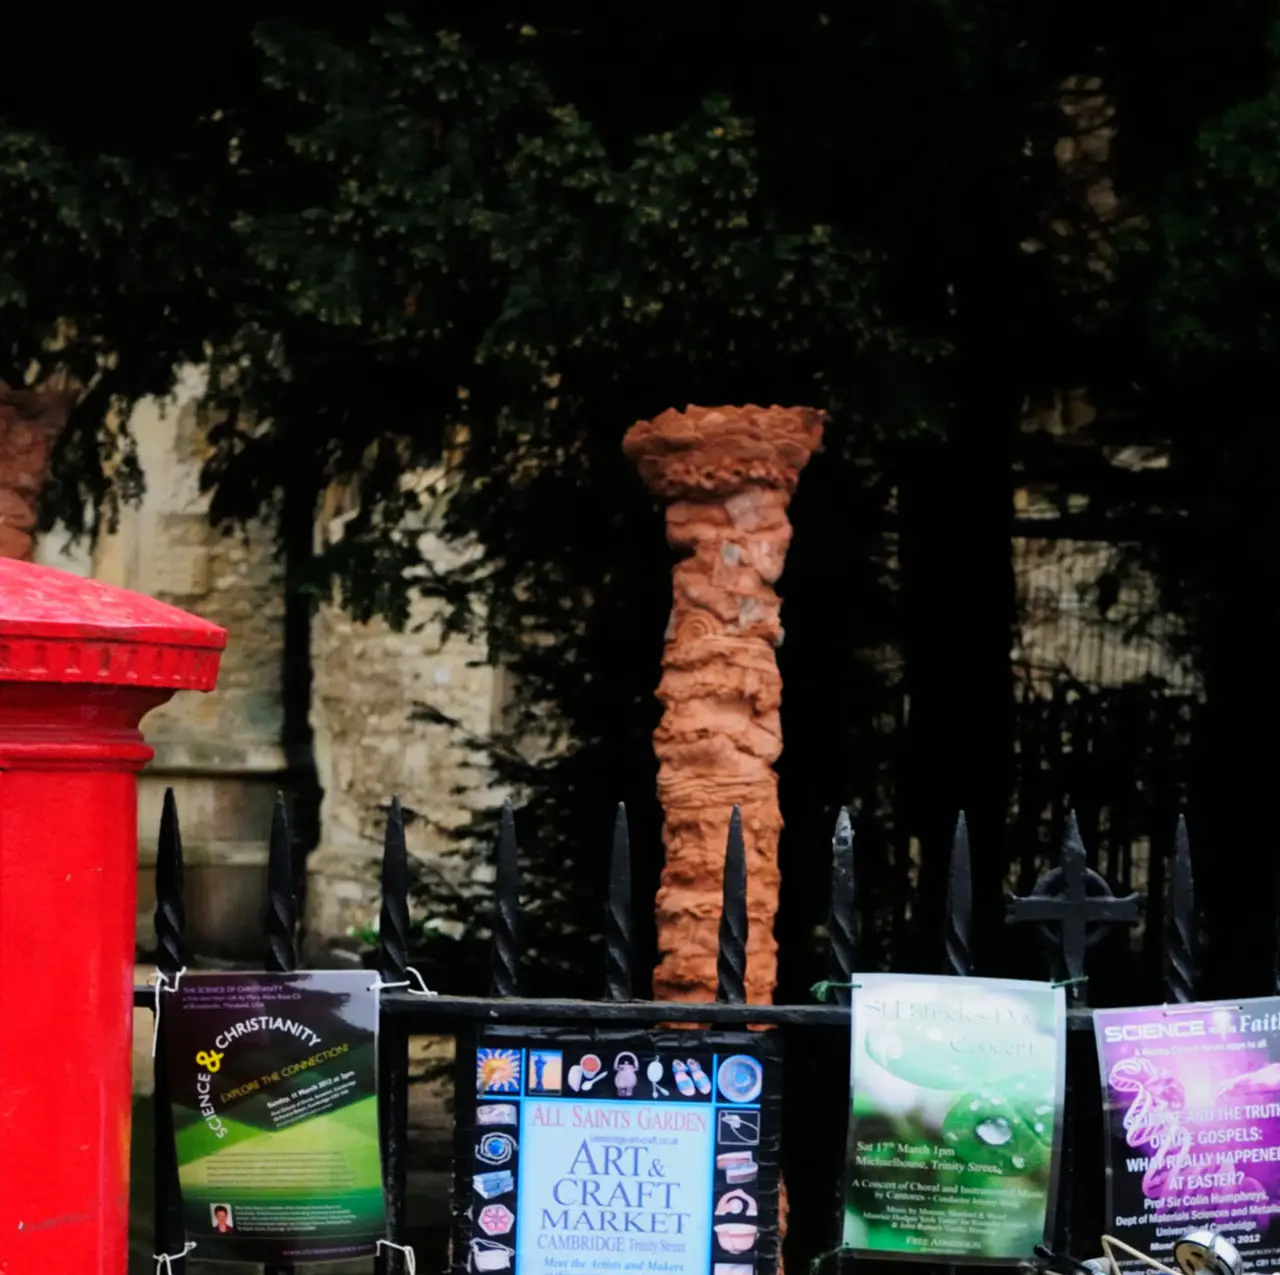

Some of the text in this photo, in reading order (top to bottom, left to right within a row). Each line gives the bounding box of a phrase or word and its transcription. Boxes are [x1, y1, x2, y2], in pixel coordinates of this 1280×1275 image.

[1104, 1020, 1206, 1043] SCIENCE
[196, 1016, 322, 1139] SCIENCE & CHRISTIANITY
[532, 1104, 707, 1133] ALL SAINTS GARDEN
[1198, 1127, 1263, 1145] GOSPELS:
[567, 1139, 666, 1178] ART &
[897, 1143, 930, 1155] March
[931, 1160, 965, 1173] Trinity
[862, 1179, 896, 1191] Concert
[910, 1181, 941, 1193] Choral
[1170, 1171, 1245, 1190] AT EASTER?
[552, 1177, 681, 1209] CRAFT
[1144, 1197, 1166, 1210] Prof
[1167, 1195, 1182, 1208] Sir
[1183, 1194, 1209, 1207] Colin
[540, 1208, 691, 1235] MARKET
[537, 1233, 625, 1252] CAMBRIDGE
